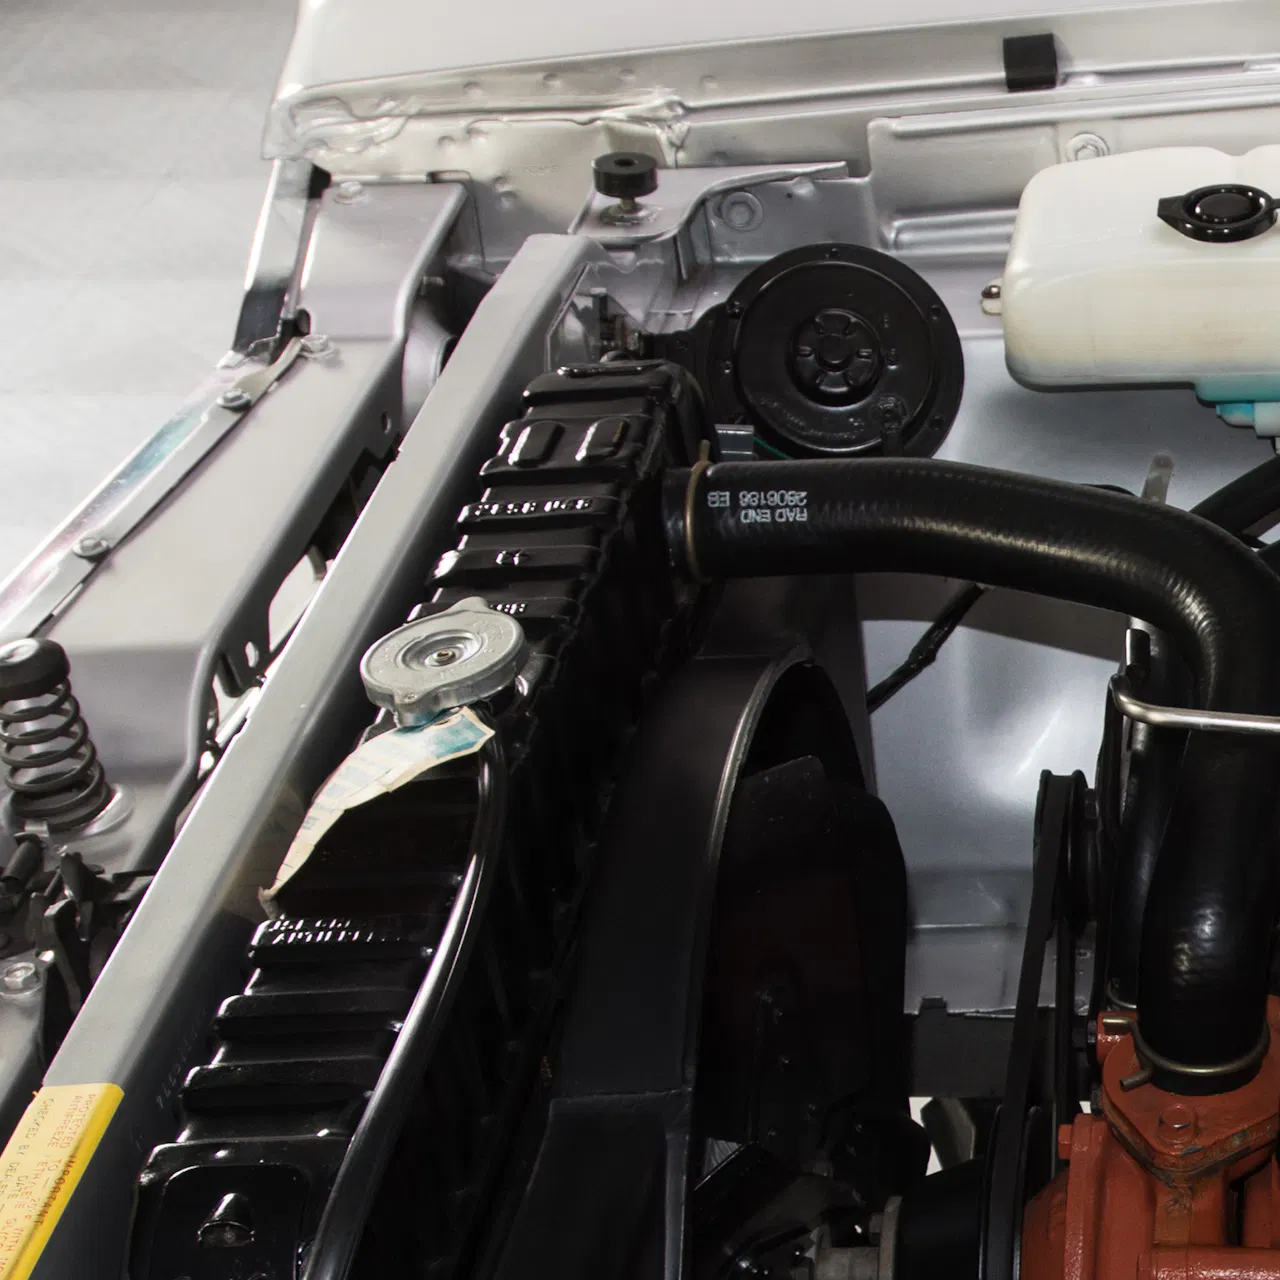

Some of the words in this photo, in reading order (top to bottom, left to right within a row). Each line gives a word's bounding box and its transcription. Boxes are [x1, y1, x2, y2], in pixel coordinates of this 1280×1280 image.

[740, 508, 771, 523] END
[774, 508, 808, 523] RAD
[60, 1094, 96, 1149] PROTECTED
[48, 1159, 63, 1172] TO
[34, 1155, 77, 1225] IMPORTANT
